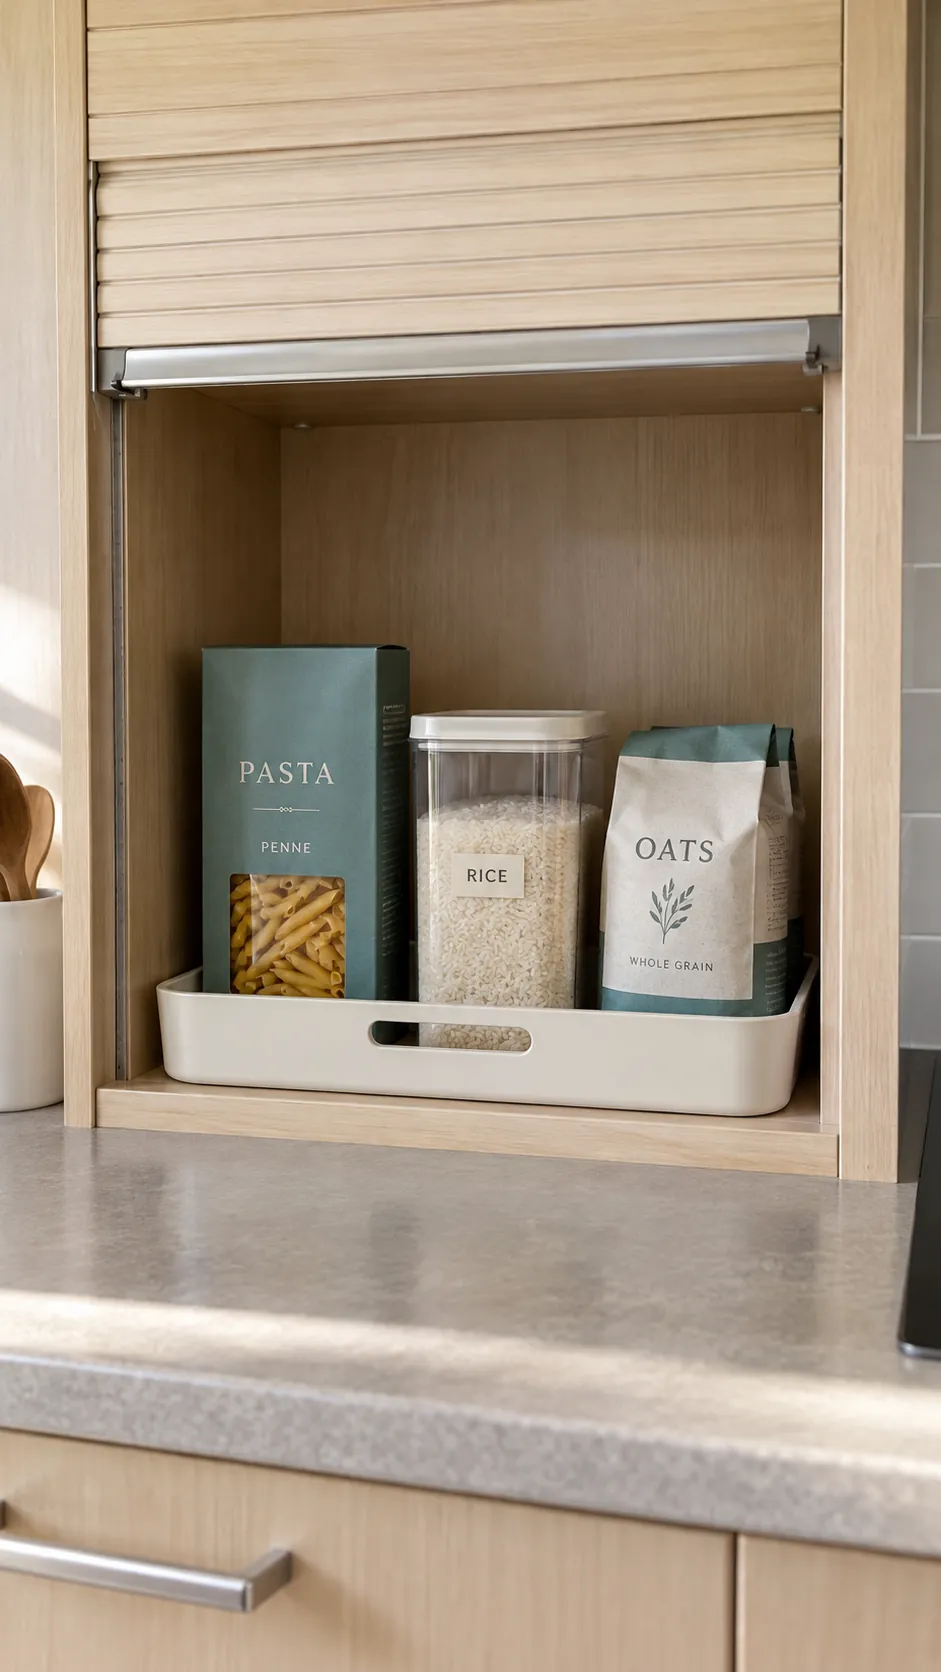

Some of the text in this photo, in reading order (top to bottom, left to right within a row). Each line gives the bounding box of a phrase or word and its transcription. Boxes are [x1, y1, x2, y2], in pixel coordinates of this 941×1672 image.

[239, 760, 335, 785] PASTA
[261, 841, 312, 854] PENNE
[635, 836, 714, 863] OATS
[467, 868, 508, 883] RICE
[629, 956, 713, 972] WHOLE GRAIN
